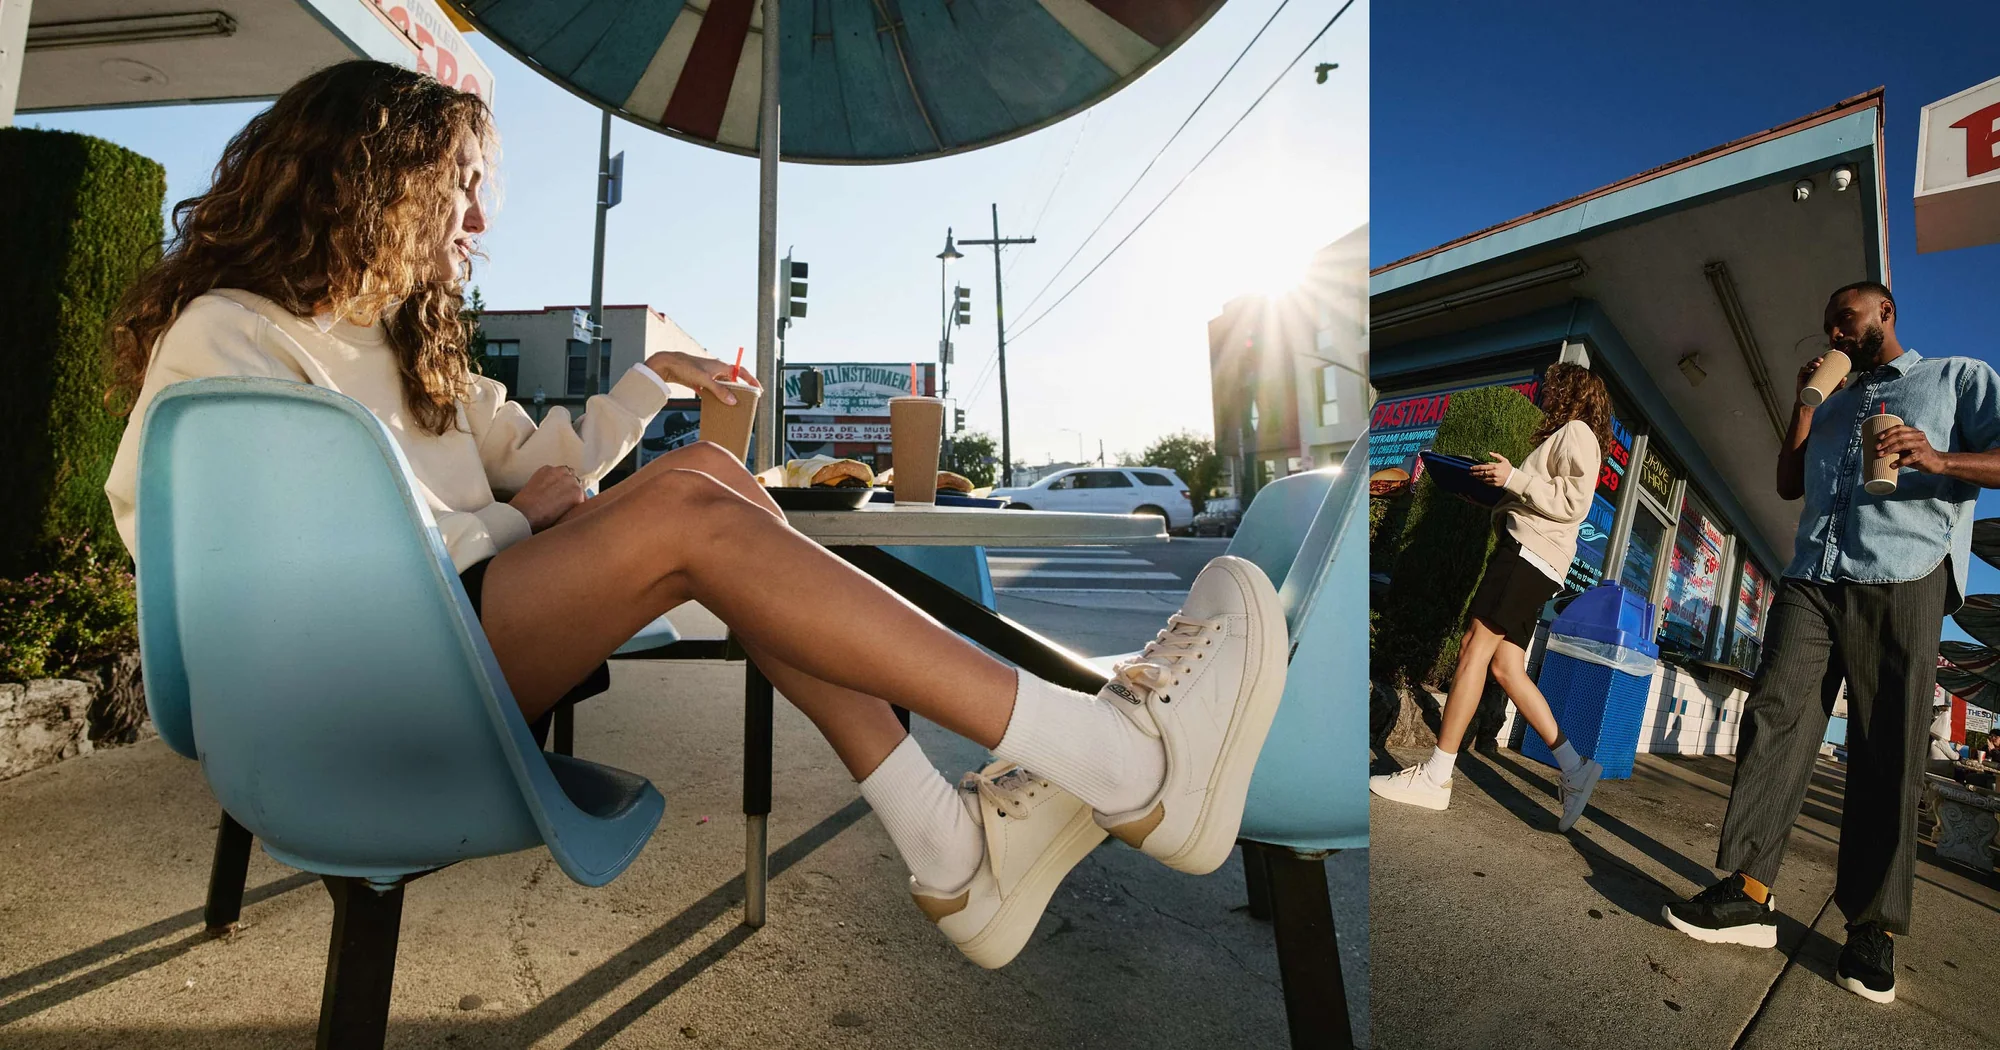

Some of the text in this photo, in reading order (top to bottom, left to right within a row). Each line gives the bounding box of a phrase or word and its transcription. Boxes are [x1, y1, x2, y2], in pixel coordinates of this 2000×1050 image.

[837, 365, 921, 393] INSTRUMEN
[791, 425, 803, 433] LA
[809, 425, 835, 433] CASA
[791, 432, 892, 441] (323) 262-942
[1369, 456, 1385, 466] ARGE
[1643, 448, 1671, 483] DRIVE
[1642, 463, 1667, 496] THRU
